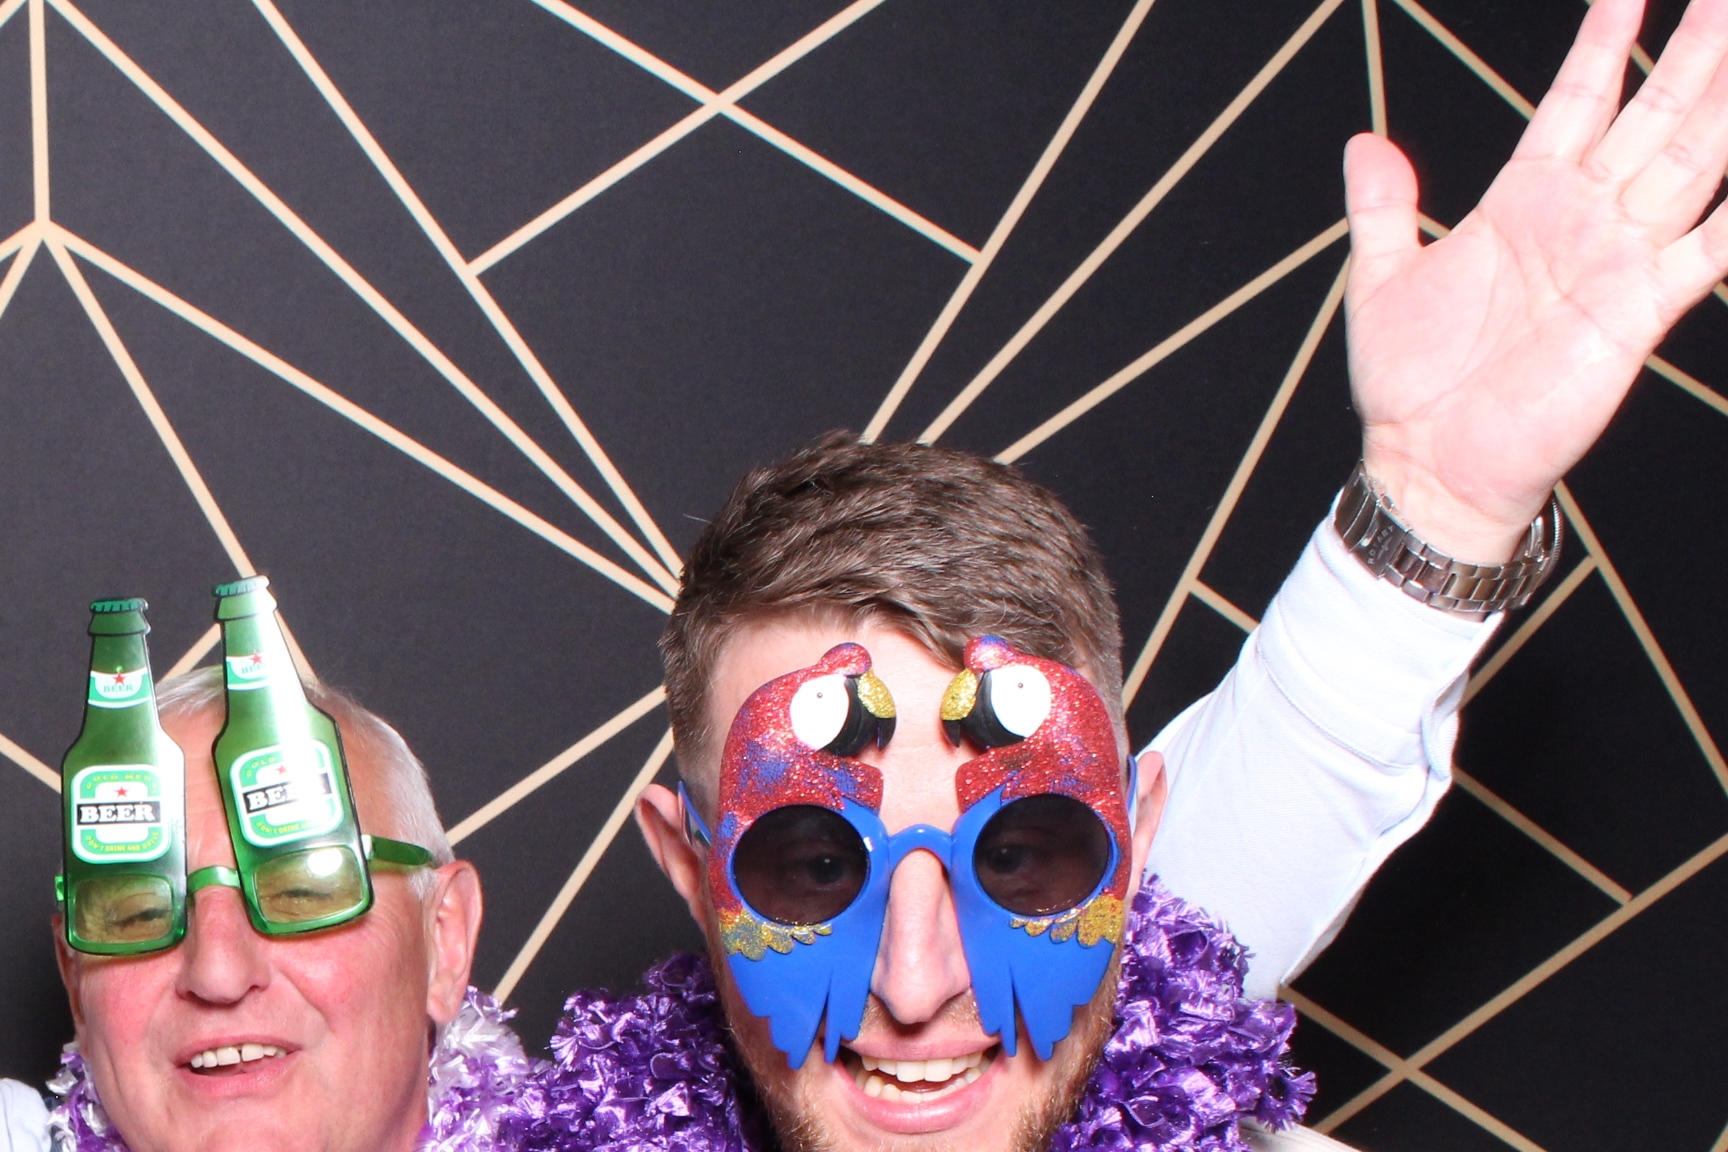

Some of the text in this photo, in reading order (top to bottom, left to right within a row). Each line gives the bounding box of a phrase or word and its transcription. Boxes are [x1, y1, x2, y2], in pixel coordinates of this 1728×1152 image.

[241, 662, 267, 675] BEE
[103, 684, 134, 693] BEER
[245, 756, 277, 778] GOLD
[86, 774, 119, 790] GOLD
[79, 804, 156, 824] BEER
